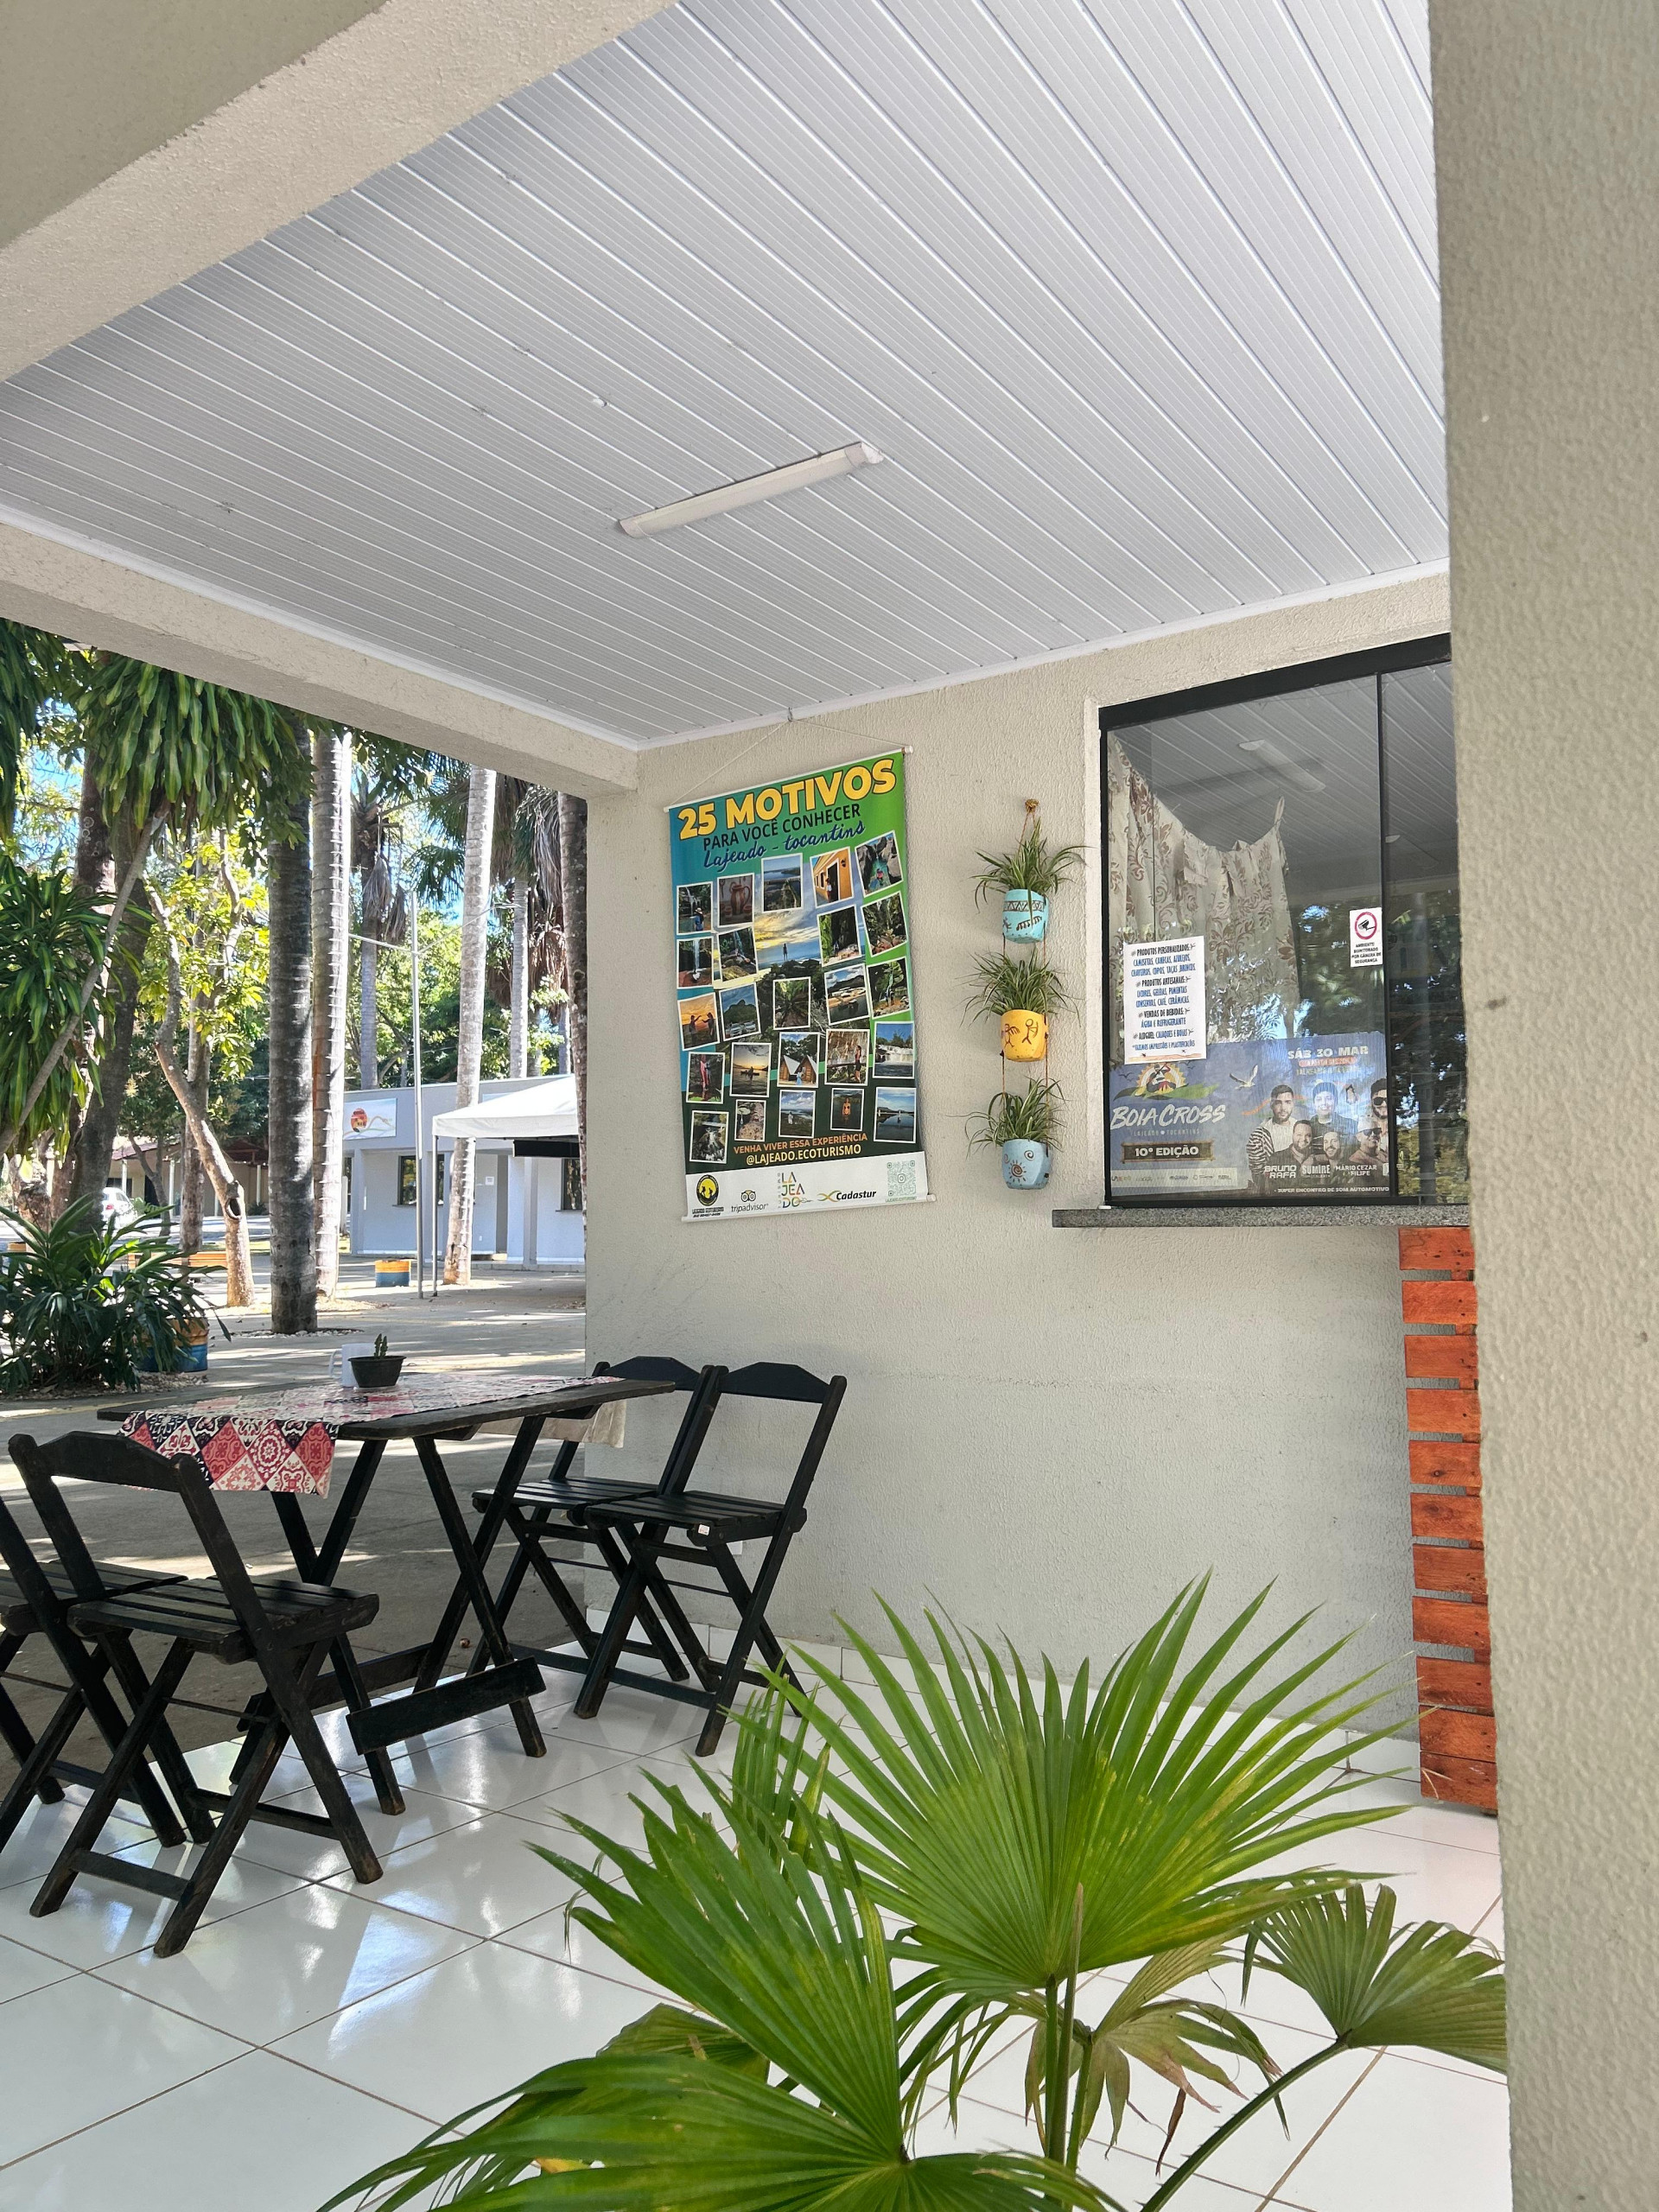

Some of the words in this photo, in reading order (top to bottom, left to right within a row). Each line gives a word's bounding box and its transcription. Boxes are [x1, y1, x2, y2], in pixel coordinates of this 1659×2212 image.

[677, 803, 718, 840] 25
[726, 759, 897, 830] MOTIVOS
[702, 834, 739, 851] PARA
[741, 818, 779, 843] VOCÊ
[782, 803, 861, 833] CONHECER
[703, 841, 768, 873] Lajeado
[785, 821, 866, 852] tocantins
[1136, 947, 1157, 957] PRODUTOS
[1141, 977, 1162, 987] PRODUTOS
[1143, 1008, 1160, 1018] VENDAS
[1160, 1007, 1166, 1017] DE
[1287, 1048, 1312, 1059] SÁB
[1317, 1047, 1333, 1058] 30
[1338, 1046, 1369, 1056] MAR
[734, 1145, 763, 1154] VENHA
[764, 1141, 788, 1152] VIVER
[789, 1139, 810, 1149] ESSA
[812, 1132, 868, 1147] EXPERIÊNCIA
[746, 1143, 861, 1166] @LAJEADO.ECOTURISMO
[1155, 1144, 1199, 1159] EDIÇÃO
[1301, 1164, 1331, 1174] SUMIRE
[836, 1190, 877, 1201] Cadastur
[730, 1203, 766, 1214] tripadvisor
